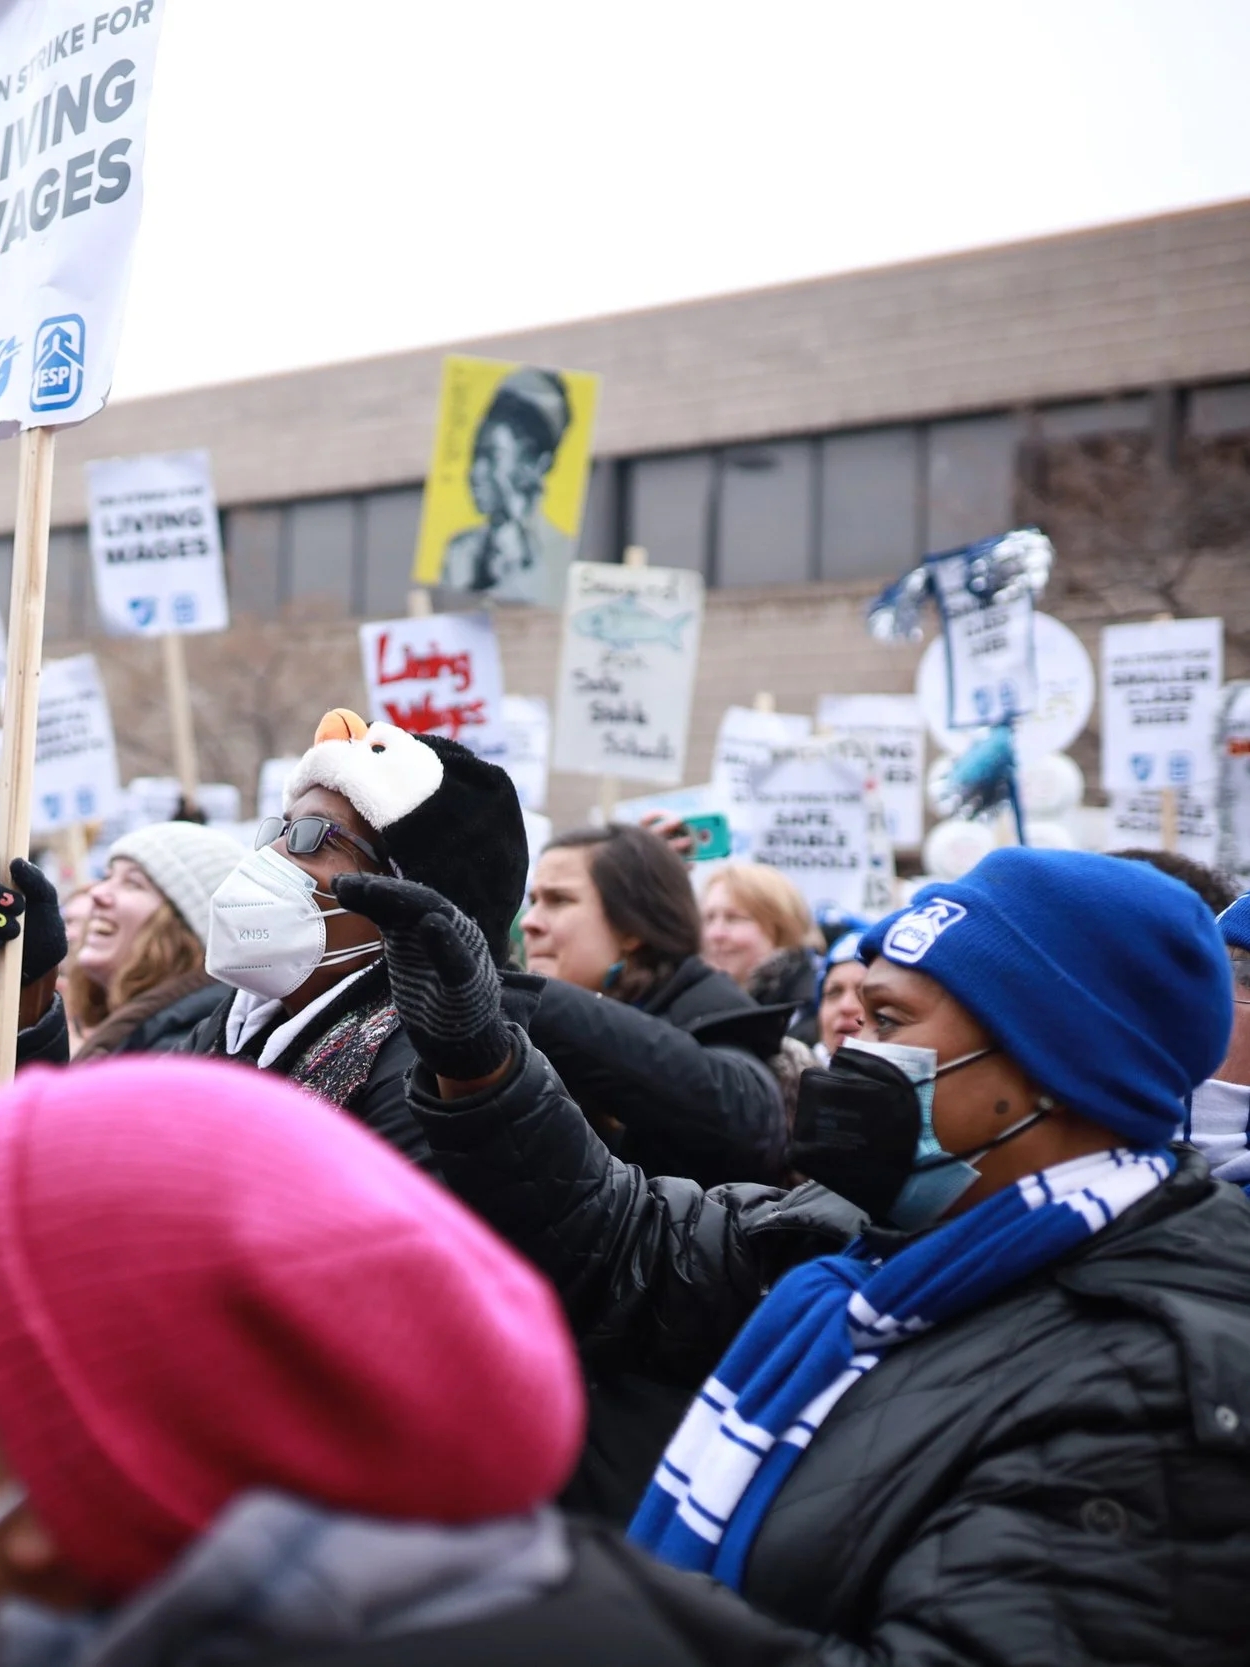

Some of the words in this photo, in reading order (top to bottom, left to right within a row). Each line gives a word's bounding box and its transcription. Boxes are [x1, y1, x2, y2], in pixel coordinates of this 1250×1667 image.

[17, 23, 84, 93] STRIKE
[92, 0, 153, 44] FOR
[38, 366, 70, 388] ESP
[102, 507, 203, 537] LIVING
[107, 537, 209, 564] WAGES
[239, 929, 270, 940] KN95
